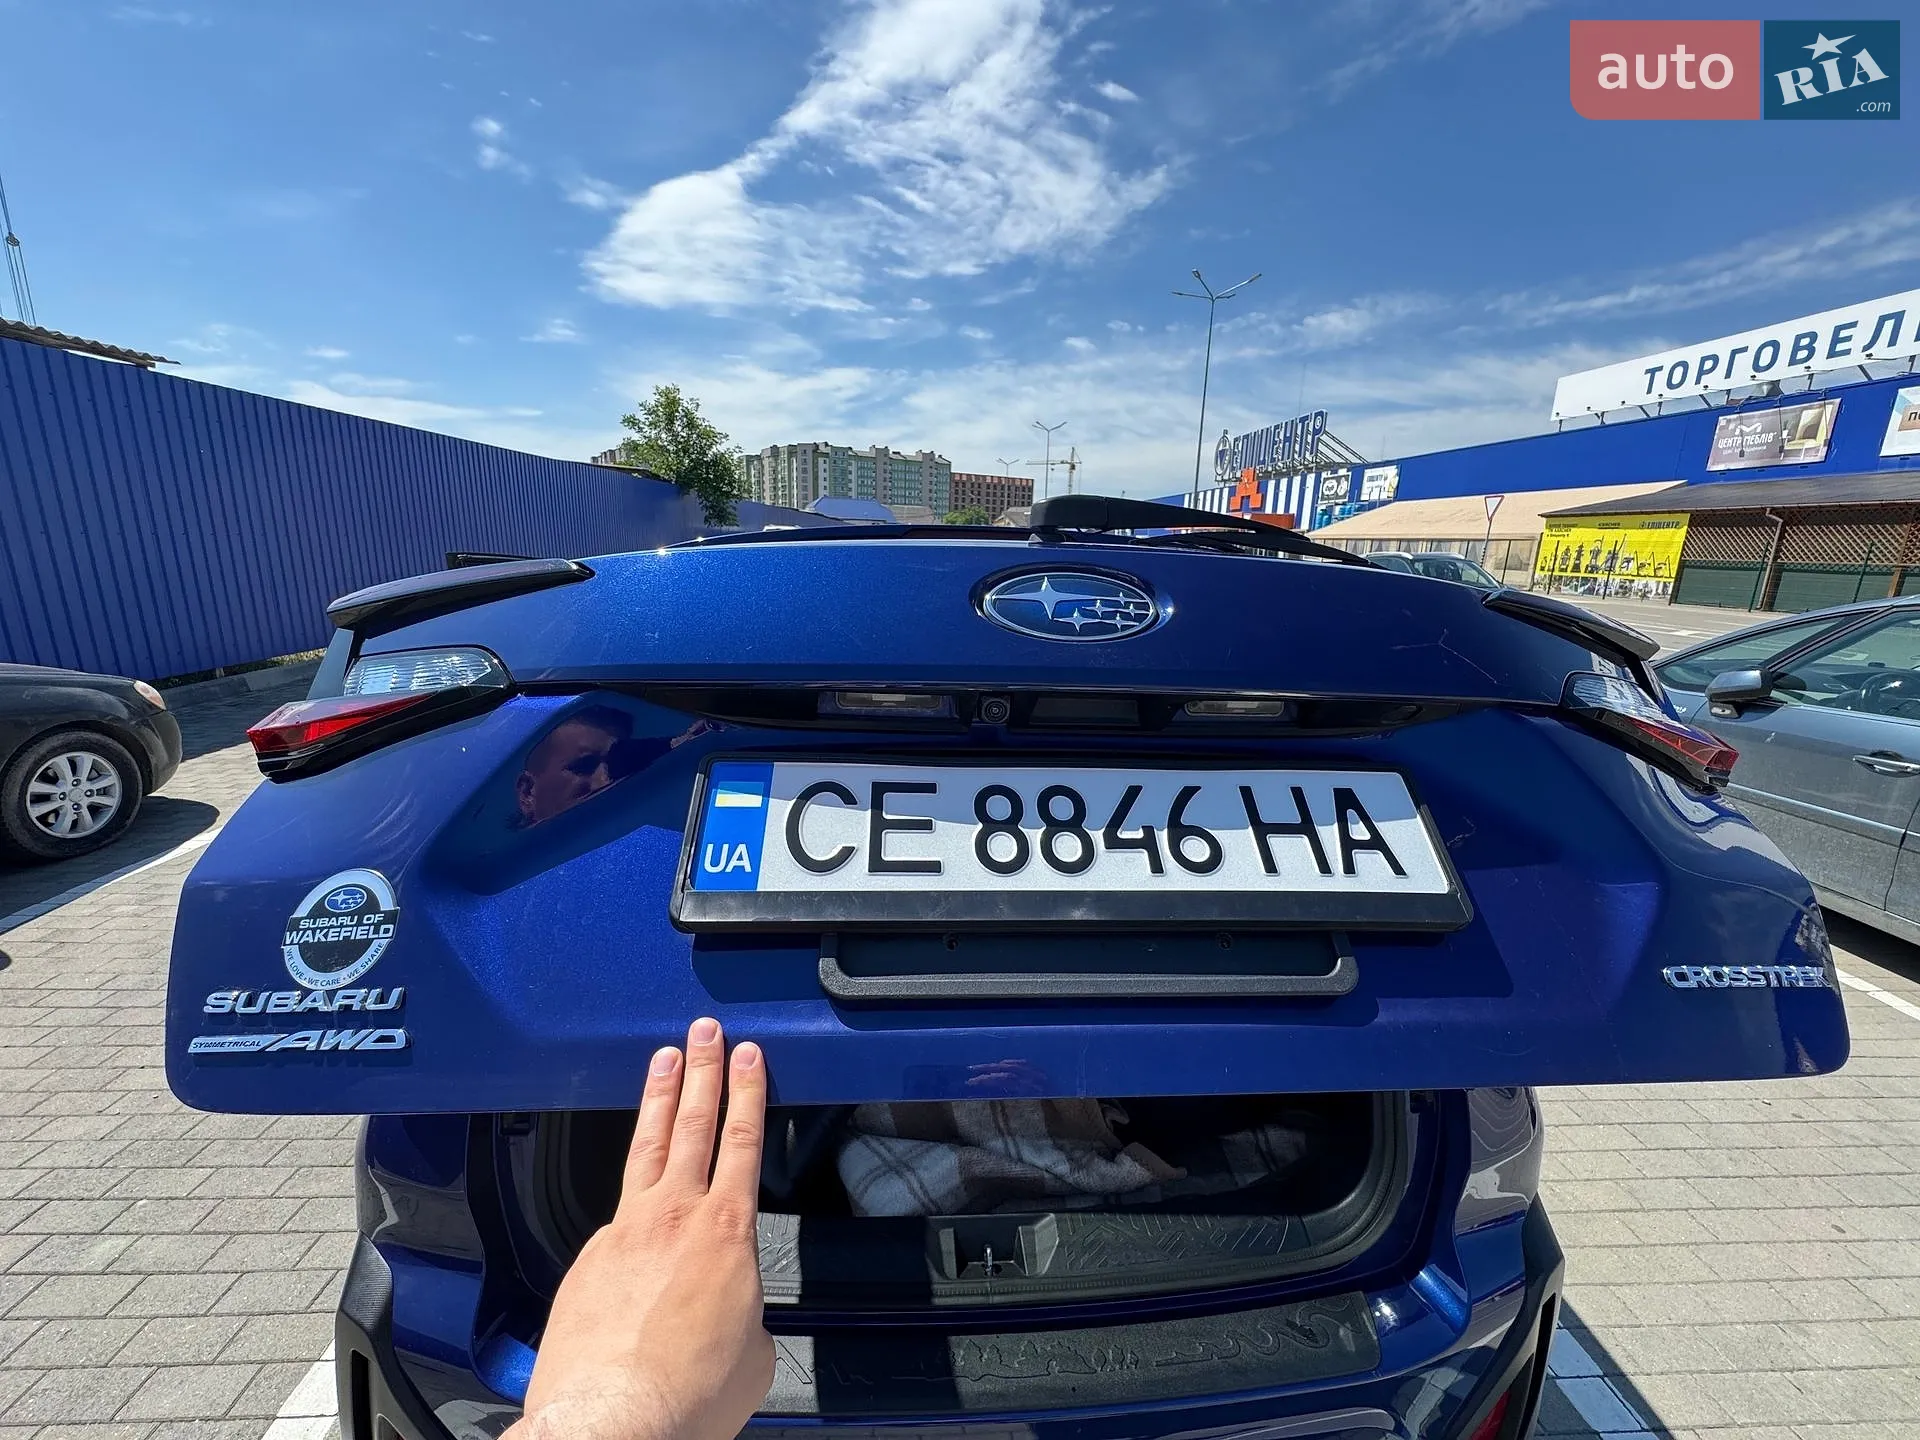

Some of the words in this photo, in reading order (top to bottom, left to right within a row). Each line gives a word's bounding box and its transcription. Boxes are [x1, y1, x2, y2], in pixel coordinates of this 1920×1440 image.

[1644, 309, 1920, 395] ТОРГОВЕЛ
[785, 781, 942, 875] CE
[972, 784, 1224, 876] 8846
[1238, 784, 1409, 877] HA
[703, 842, 753, 874] UA
[285, 924, 394, 945] WAKEFIELD
[299, 914, 358, 929] SUBARU
[362, 913, 385, 924] OF
[289, 961, 305, 980] LOVE
[320, 977, 341, 987] CARE
[360, 942, 385, 969] SHARE
[1662, 965, 1832, 988] CROSSTREK
[203, 987, 405, 1014] SUBARU
[192, 1039, 262, 1050] SYMMETRICAL
[265, 1028, 408, 1052] AWD
